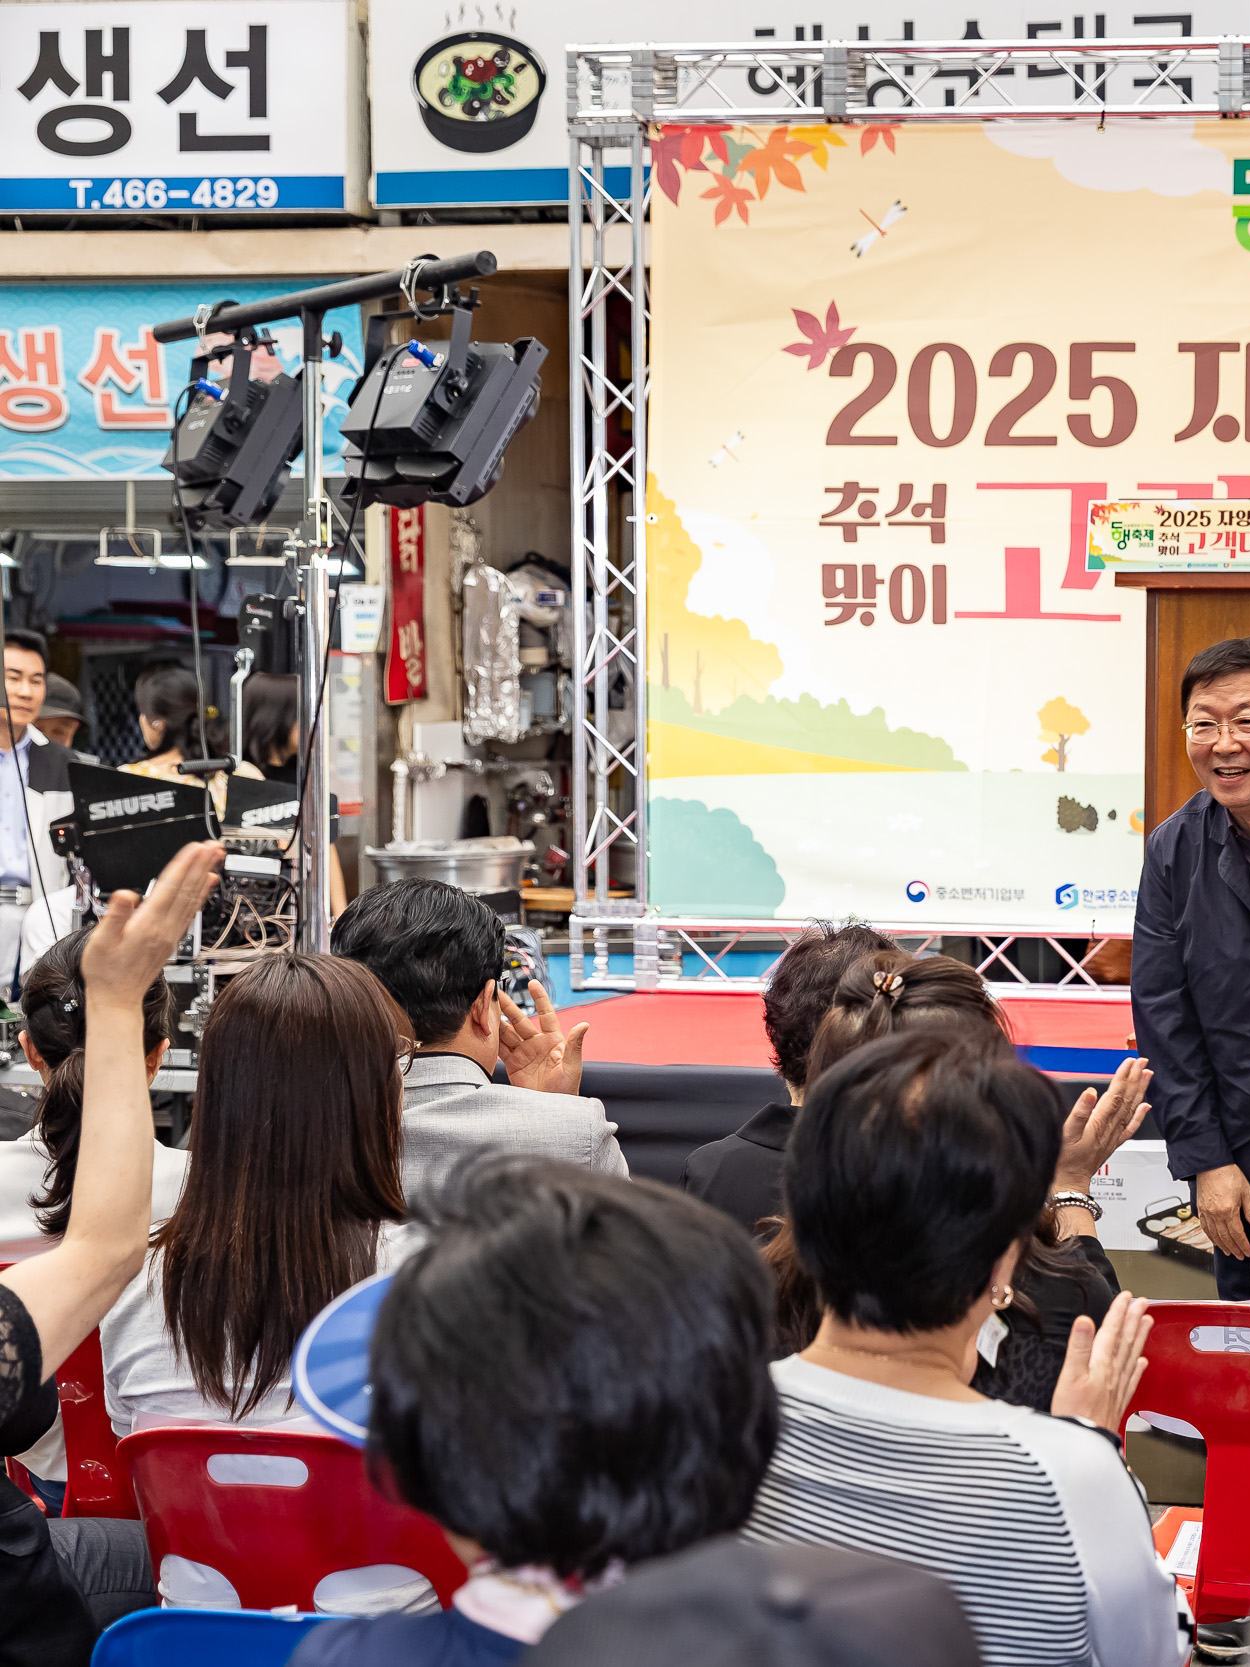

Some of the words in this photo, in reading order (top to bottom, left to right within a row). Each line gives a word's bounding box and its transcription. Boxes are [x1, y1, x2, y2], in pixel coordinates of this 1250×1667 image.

[17, 25, 271, 156] 생선
[69, 179, 279, 210] T.466-4829
[0, 328, 170, 430] 생선
[825, 342, 1138, 448] 2025
[819, 481, 947, 544] 추석
[1160, 510, 1211, 528] 2025
[821, 564, 947, 626] 맞이
[88, 790, 177, 821] SHURE
[241, 800, 300, 828] SHUR
[1091, 1177, 1124, 1187] 이드그릴
